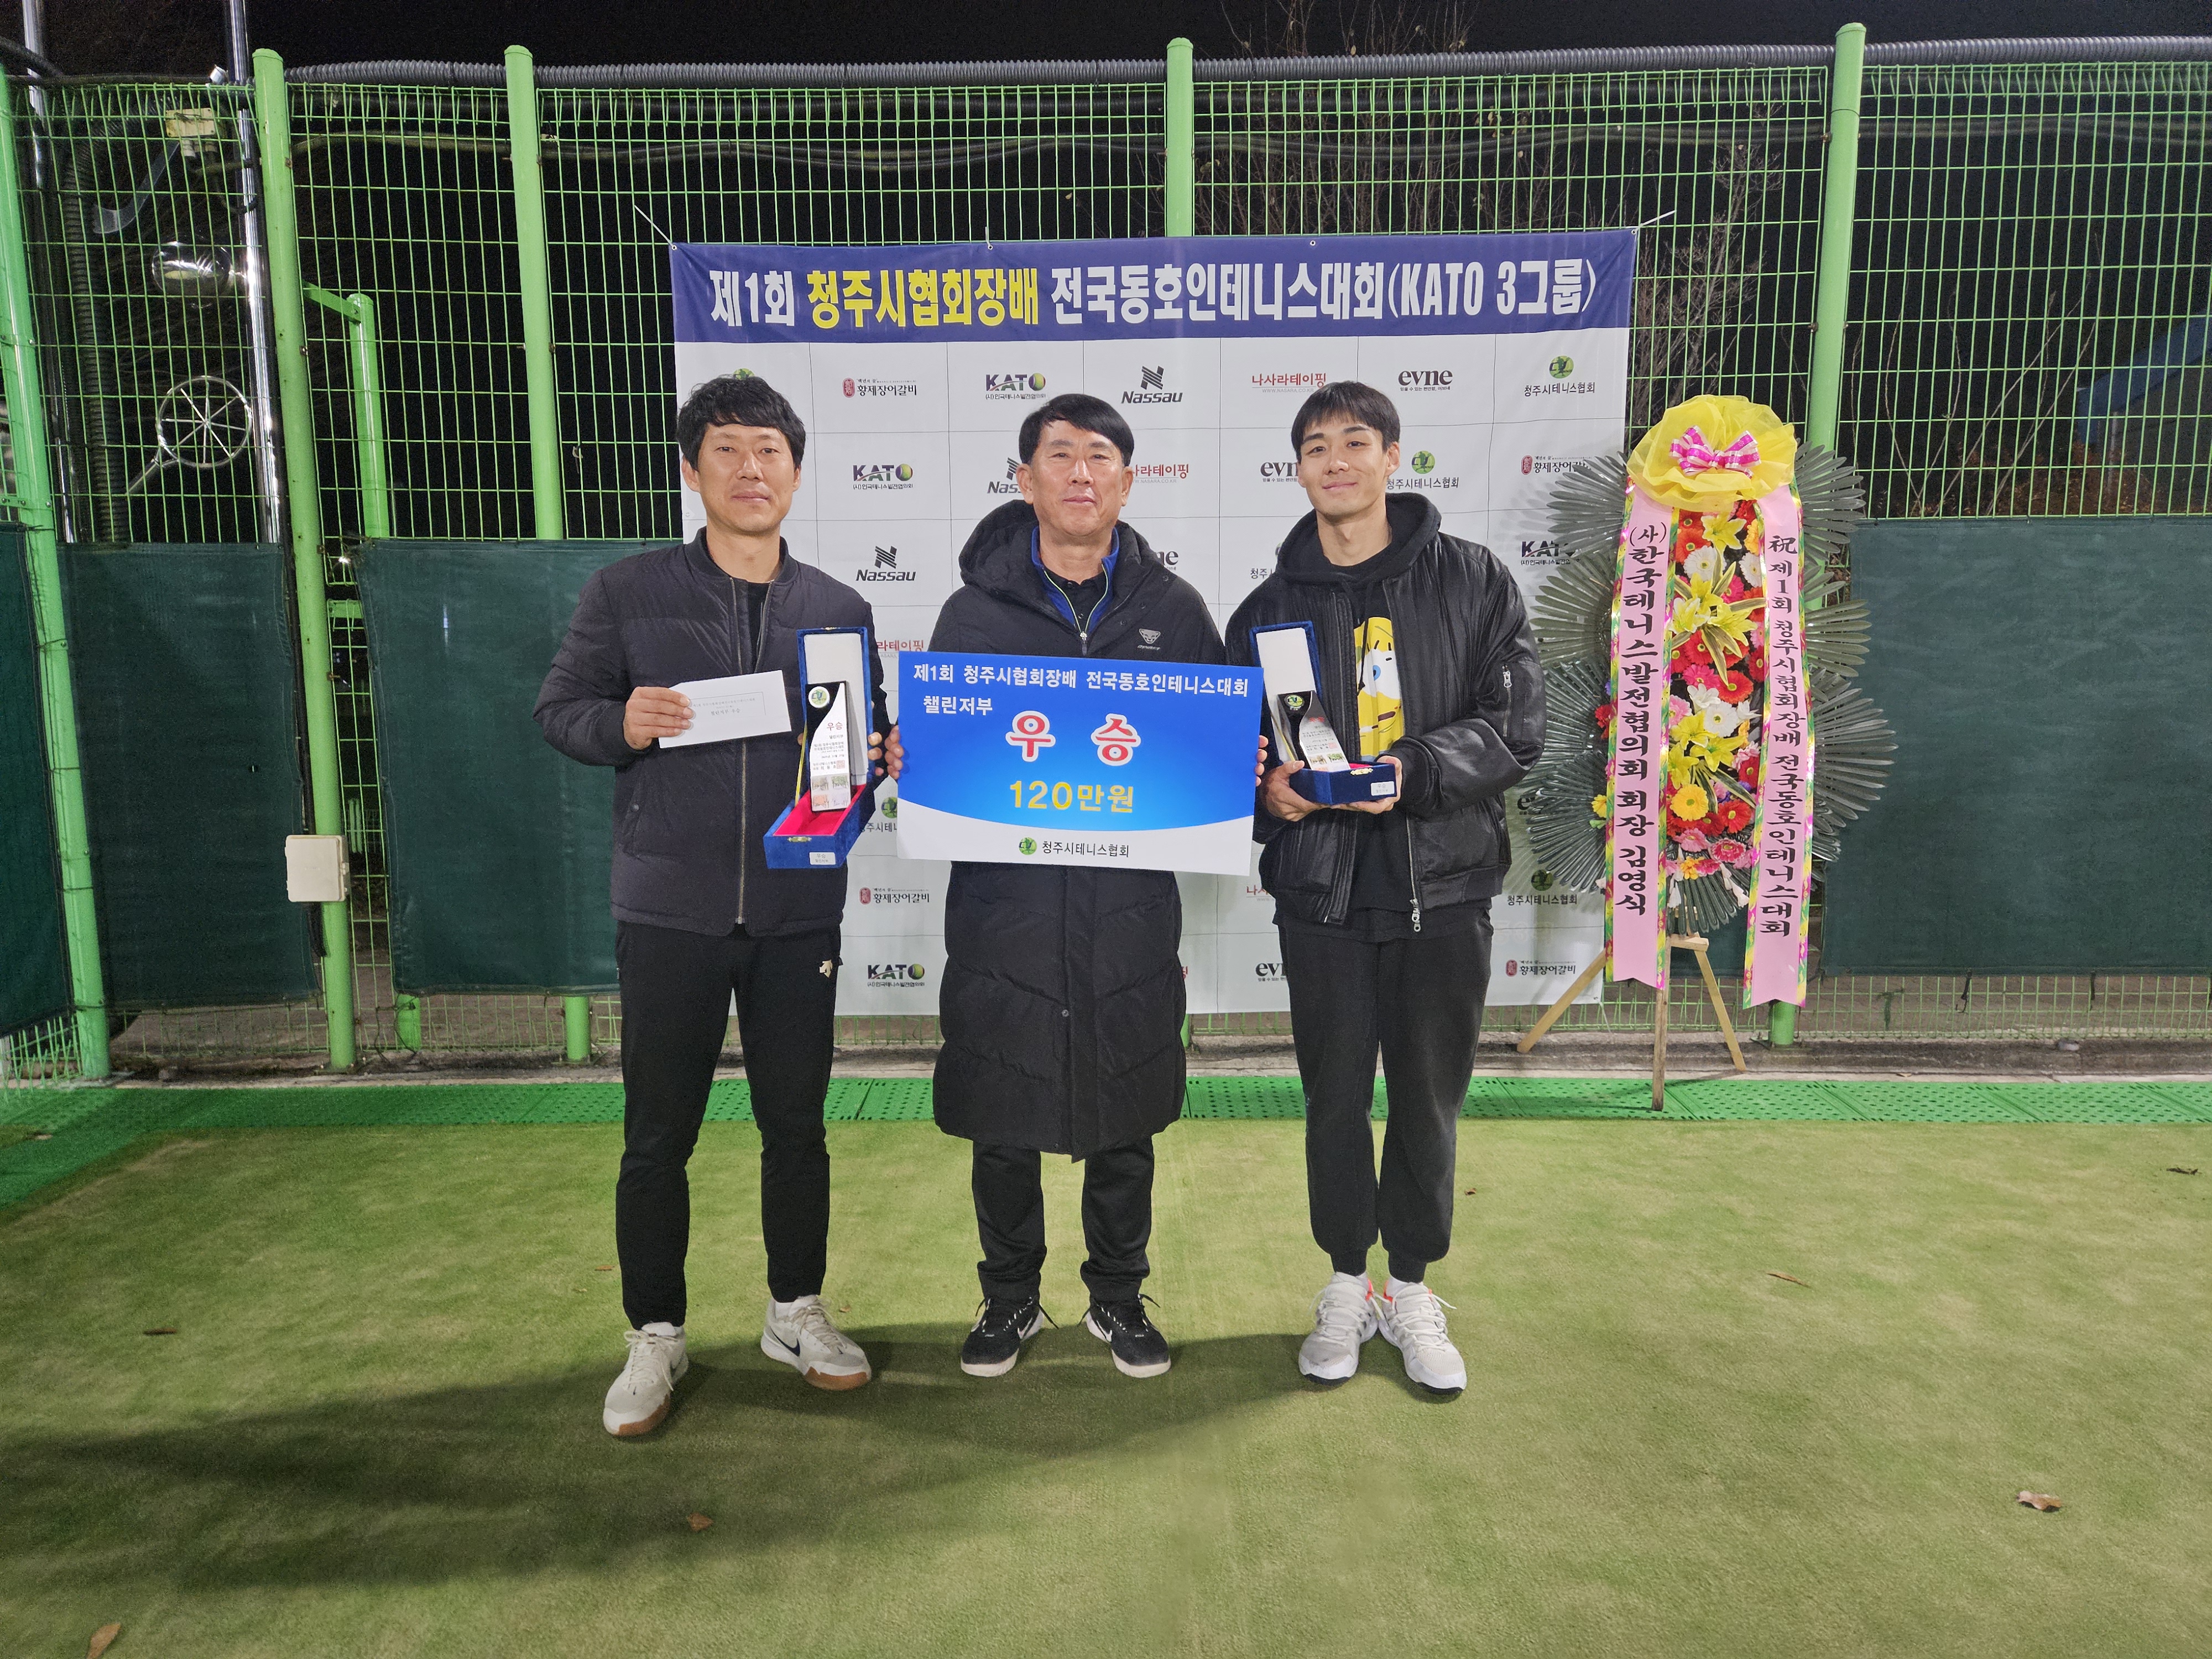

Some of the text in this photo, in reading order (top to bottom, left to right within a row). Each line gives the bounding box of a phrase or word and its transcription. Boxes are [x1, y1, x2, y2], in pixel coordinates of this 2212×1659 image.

[709, 270, 795, 327] 제1회
[807, 268, 1039, 328] 청주시협회장배
[1498, 258, 1596, 315] 3그룹)
[986, 373, 1046, 391] KATO
[1252, 373, 1326, 388] 나사라테이핑
[1398, 370, 1453, 386] evne
[857, 385, 917, 397] 황제장어갈비
[1121, 390, 1183, 404] Nassau
[1524, 382, 1595, 397] 청주시테니스협회
[853, 463, 913, 482] KATO
[1133, 463, 1188, 479] 라테이핑
[1260, 462, 1298, 477] evn
[1533, 461, 1590, 473] 황제장어
[987, 481, 1022, 493] Nas
[1387, 477, 1459, 489] 청주시테니스협회
[1768, 535, 1798, 555] 祝
[856, 570, 916, 581] Nassau
[877, 640, 923, 651] 라테이핑
[914, 664, 1248, 697] 제1회 청주시협회장배 전국동호인테니스대회
[923, 695, 993, 716] 챌린저부
[827, 722, 843, 731] 우승
[1759, 560, 1806, 938] 제1회 청주시협회장배 전국동호인테니스대회
[1010, 780, 1134, 813] 120만원
[1616, 790, 1655, 837] 회장
[1042, 841, 1129, 858] 청주시테니스협회
[1614, 846, 1648, 916] 김영식
[873, 893, 930, 903] 황제장어갈비
[1507, 895, 1577, 906] 청주시테니스협회
[868, 963, 925, 980] KATO
[1519, 965, 1576, 975] 황제장어갈비
